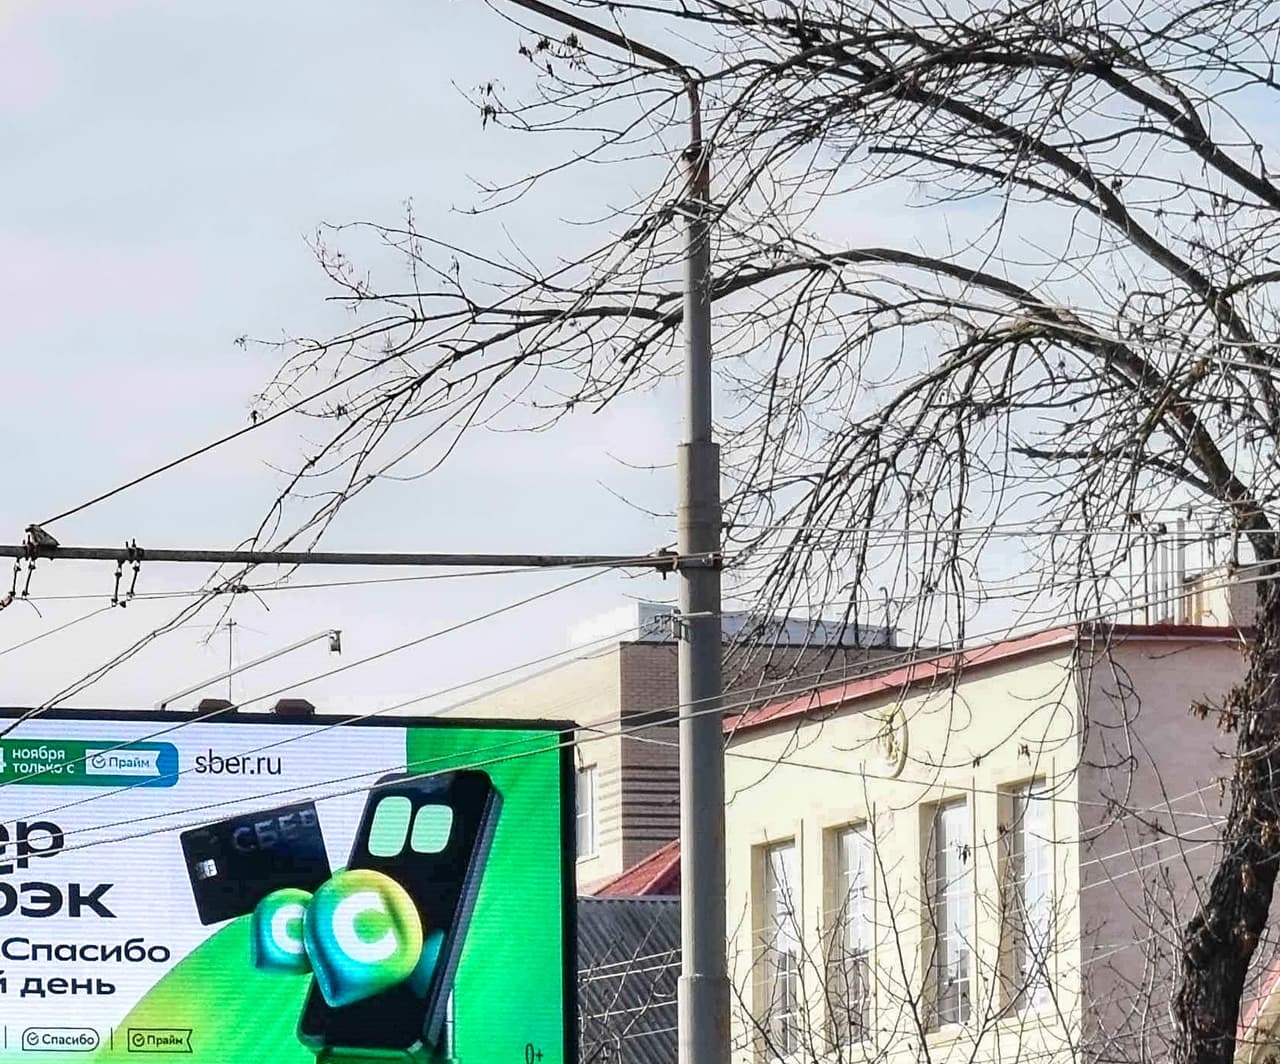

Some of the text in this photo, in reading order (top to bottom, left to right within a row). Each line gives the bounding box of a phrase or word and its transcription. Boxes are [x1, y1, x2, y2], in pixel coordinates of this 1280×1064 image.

[12, 745, 65, 762] ноября
[195, 748, 281, 775] sber.ru
[13, 762, 75, 775] только с
[109, 756, 150, 770] Прайм
[1, 937, 171, 963] Спасибо
[20, 974, 116, 999] день
[42, 1031, 95, 1048] Спасибо
[147, 1034, 184, 1047] Прайм
